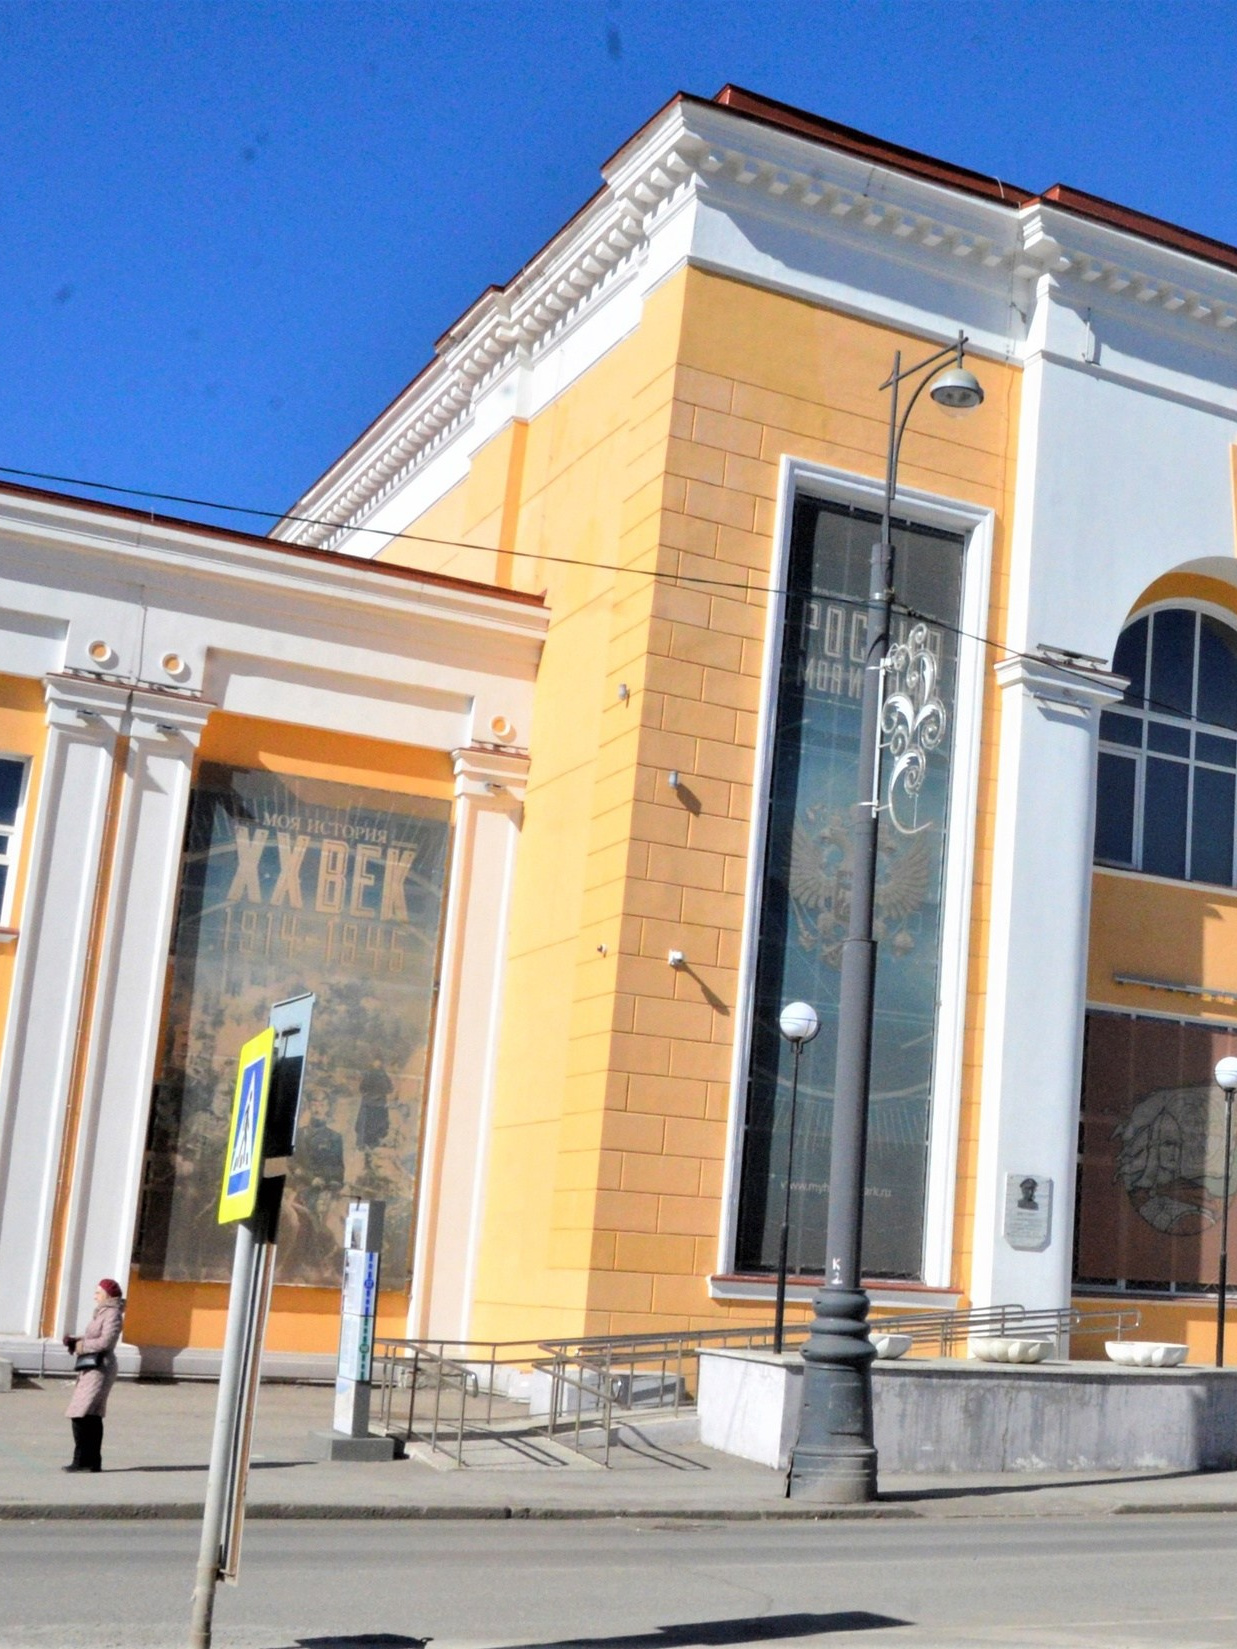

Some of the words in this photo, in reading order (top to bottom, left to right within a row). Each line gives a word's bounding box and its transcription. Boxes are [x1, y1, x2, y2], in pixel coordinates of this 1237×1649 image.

[263, 811, 301, 830] МОЯ
[307, 819, 388, 843] ИСТОРИЯ
[315, 838, 416, 923] ВЕК
